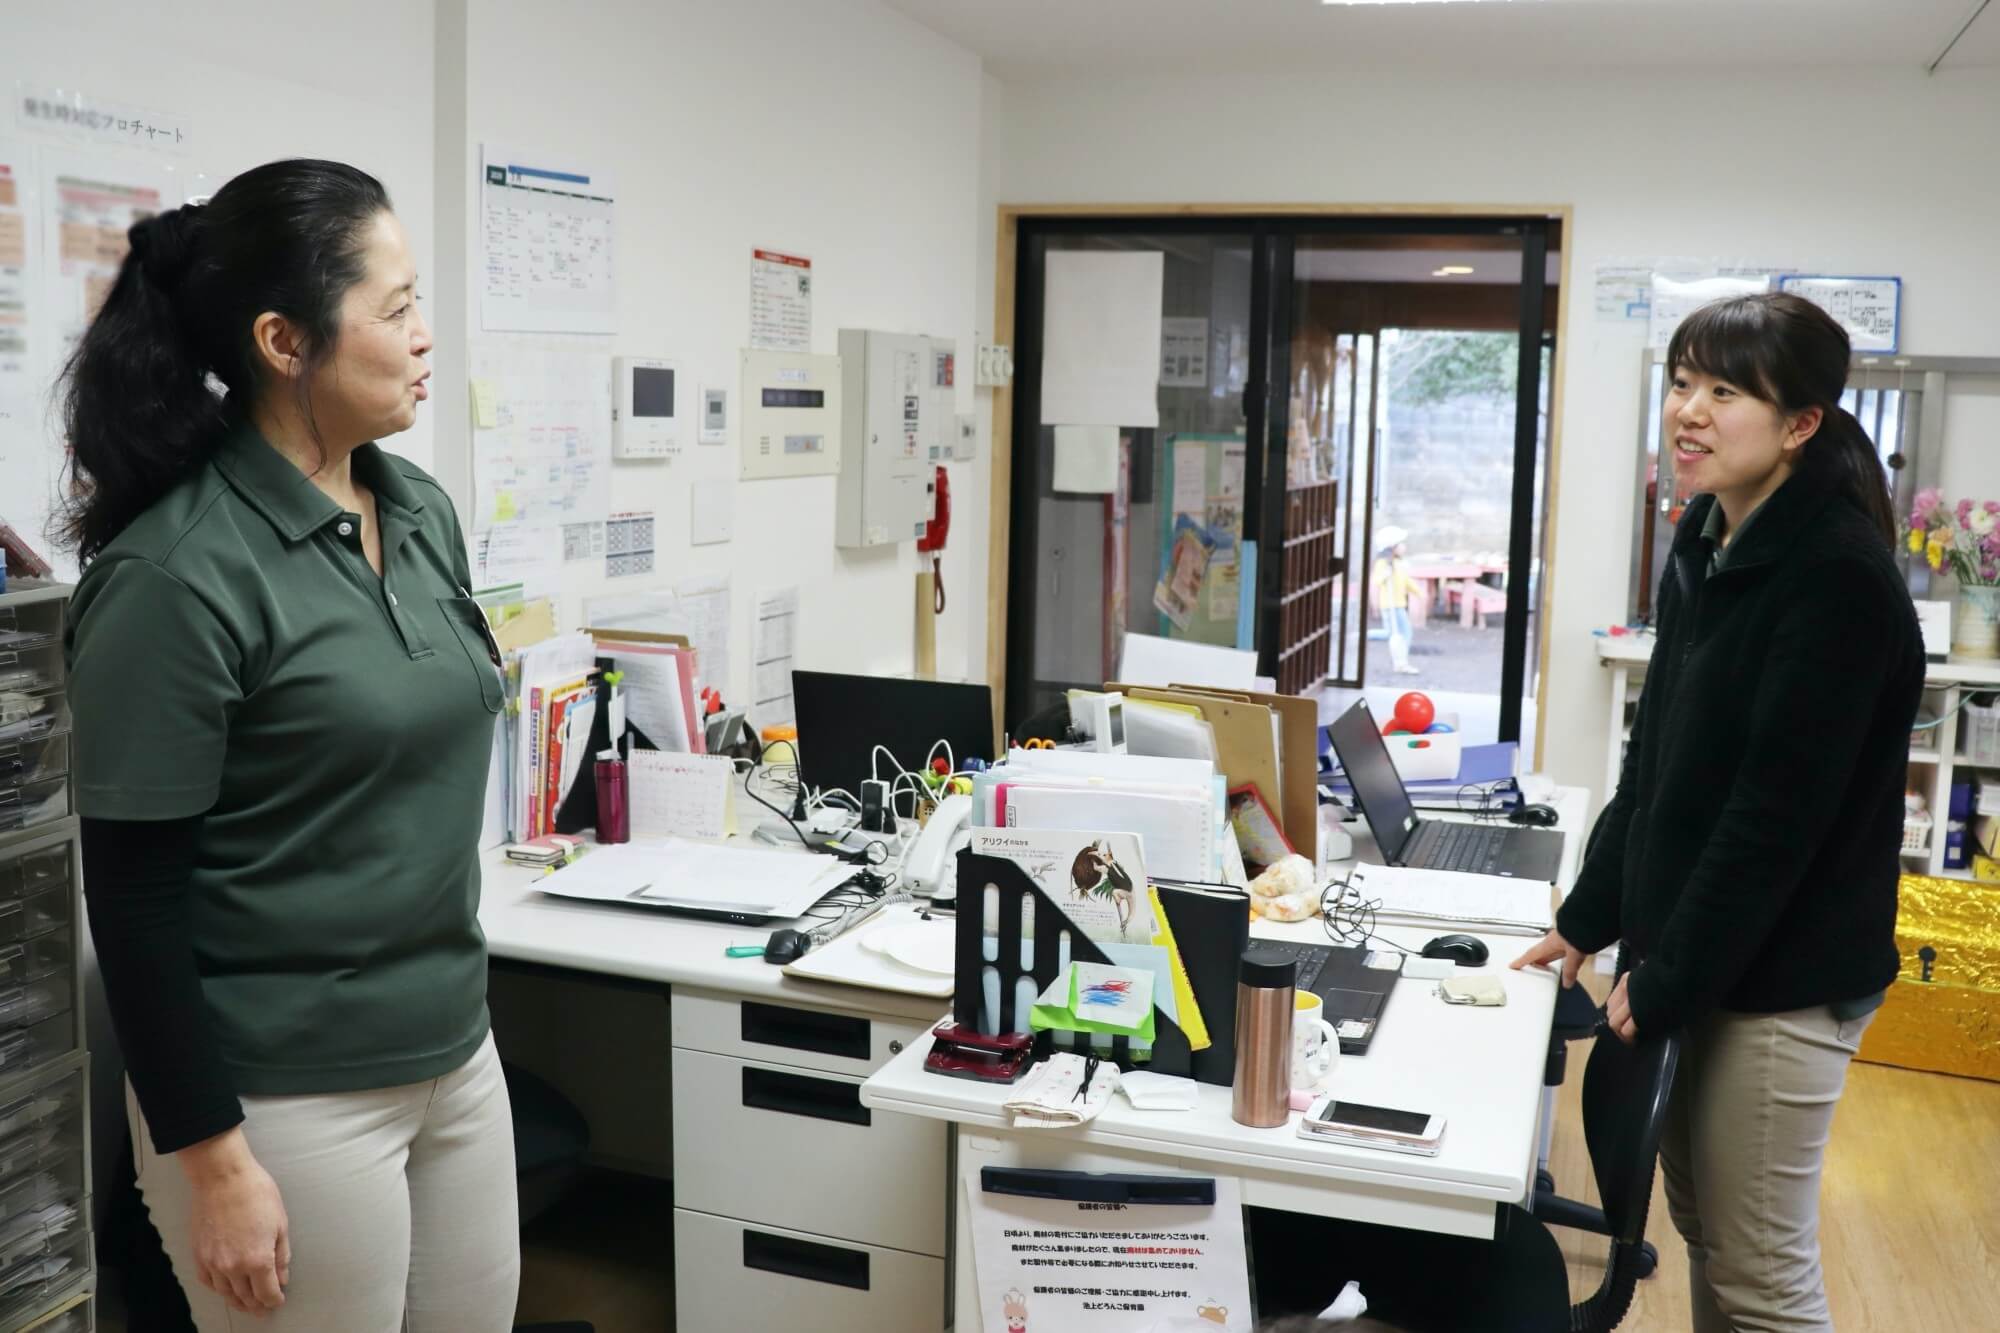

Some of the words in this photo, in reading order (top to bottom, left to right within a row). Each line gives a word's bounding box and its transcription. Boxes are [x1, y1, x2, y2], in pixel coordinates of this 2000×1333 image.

[1083, 1302, 1145, 1311] 池上どろんこ保育園
